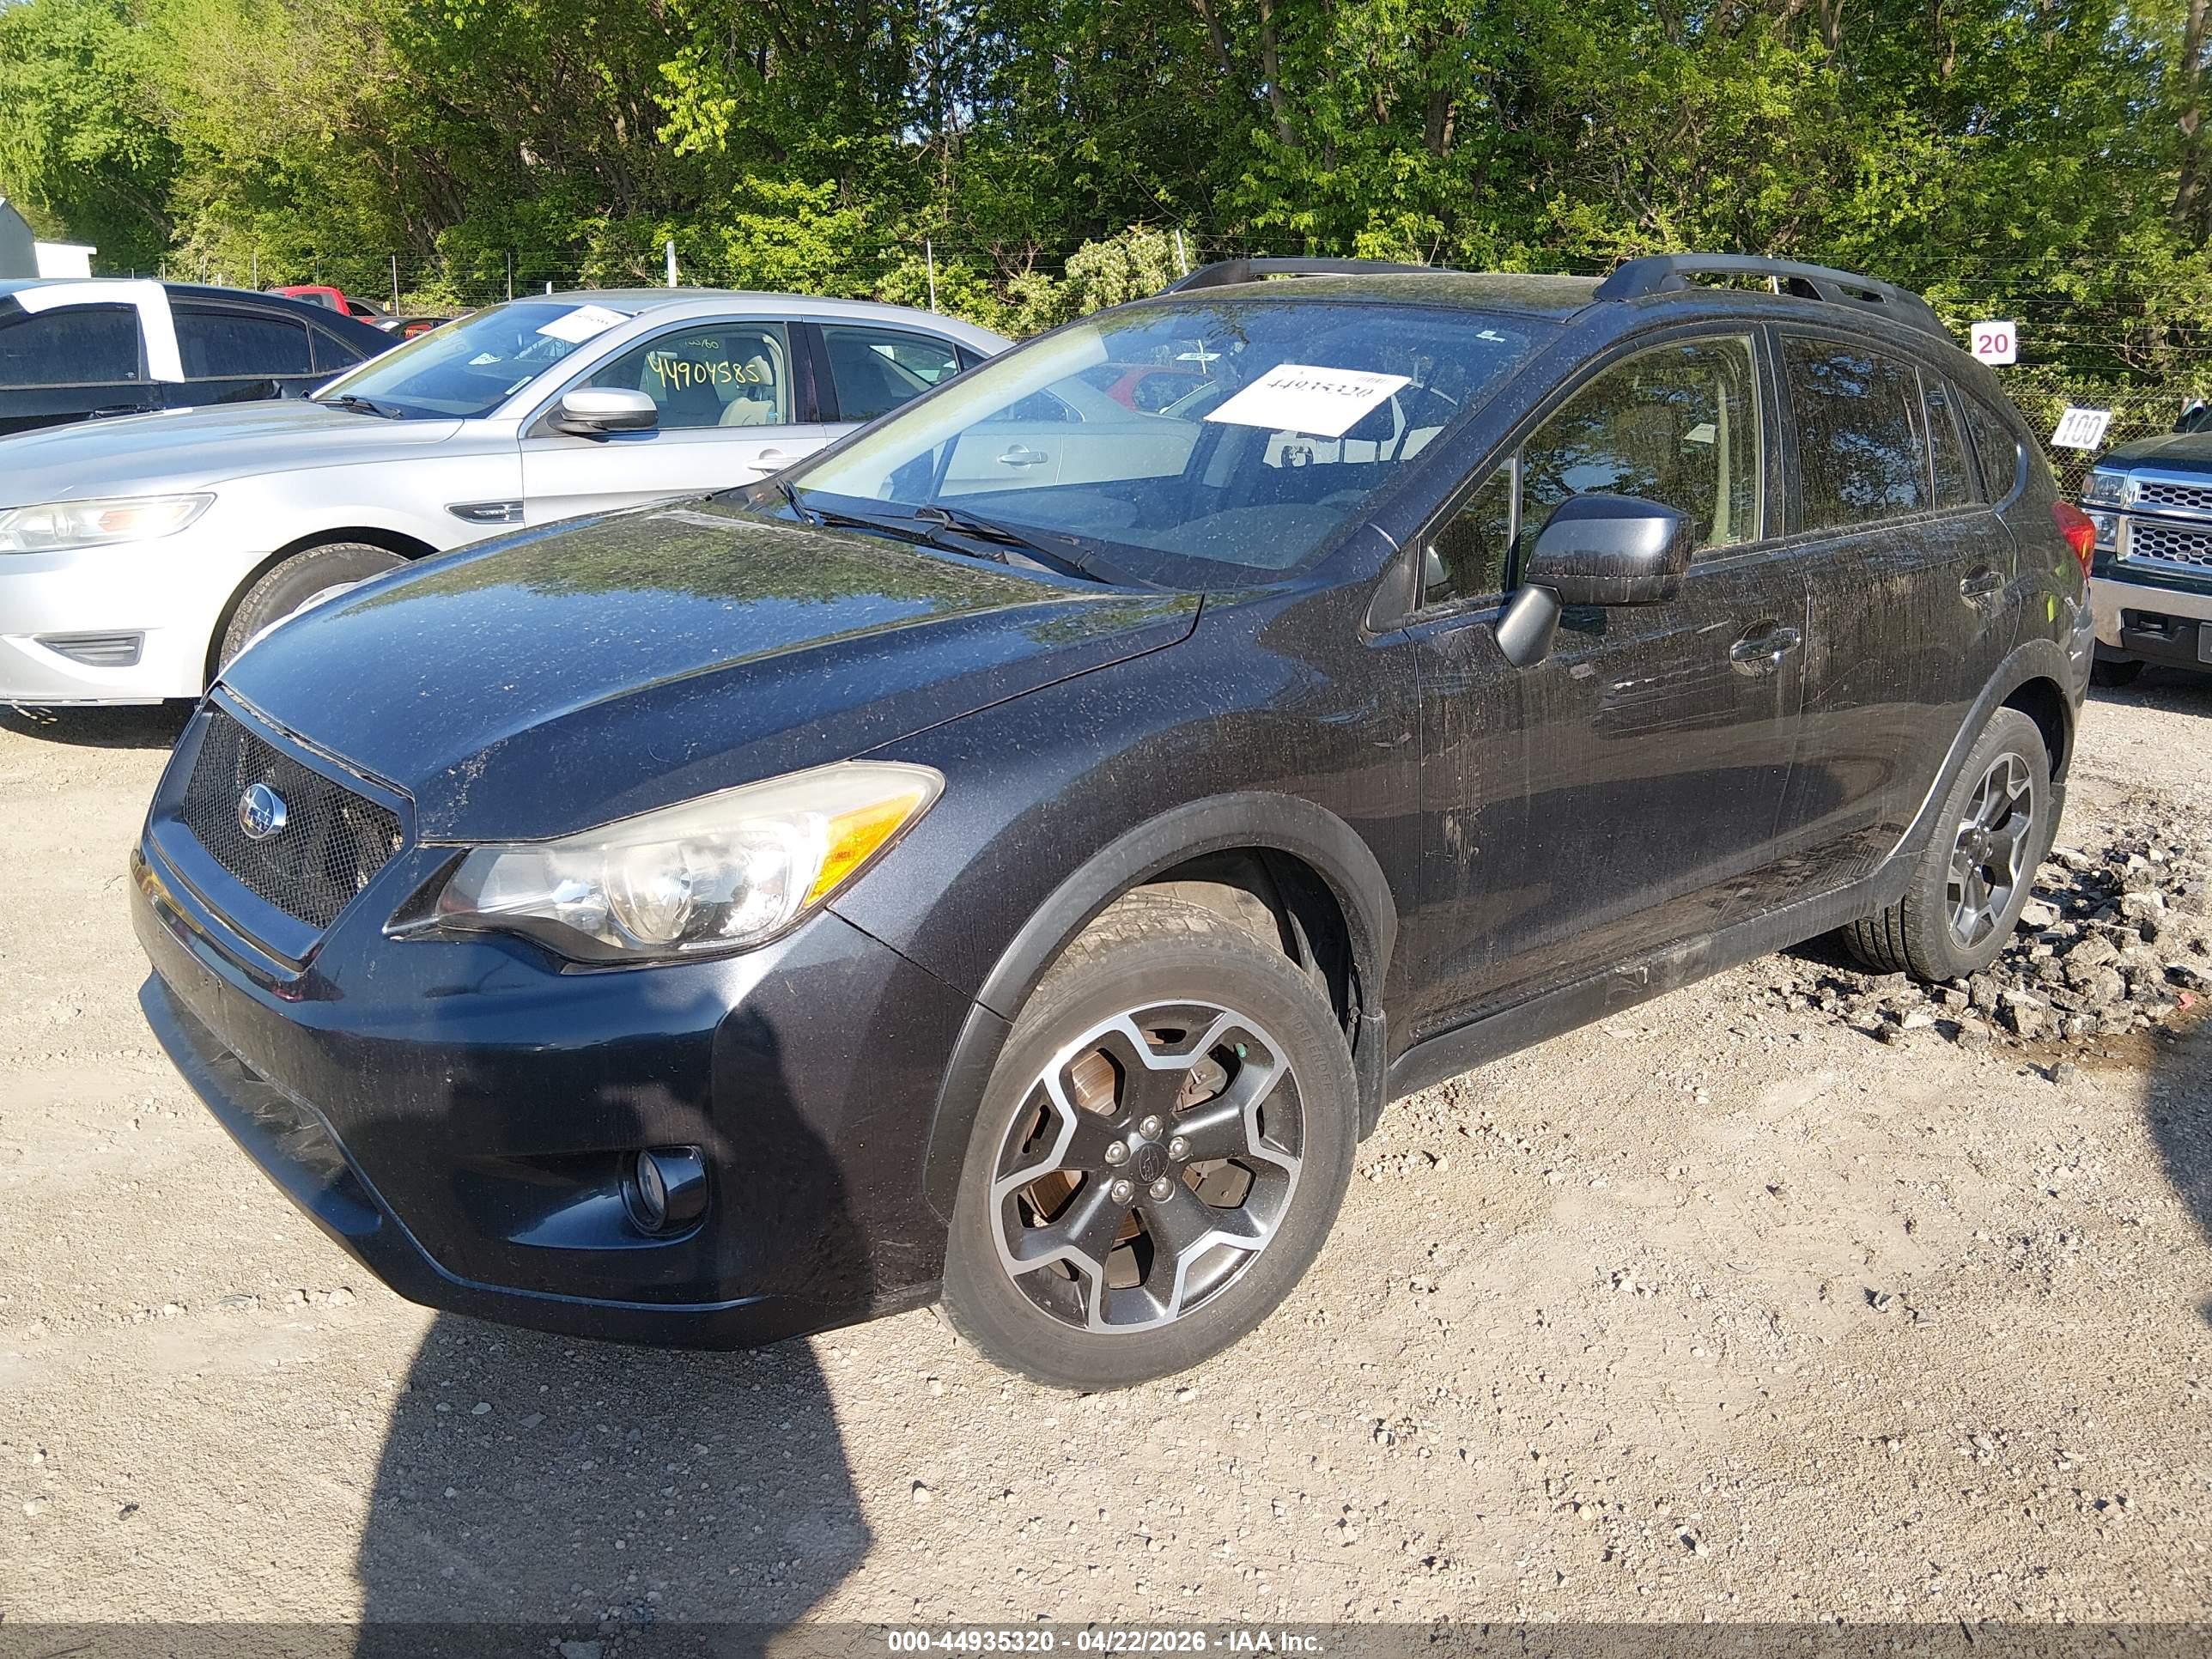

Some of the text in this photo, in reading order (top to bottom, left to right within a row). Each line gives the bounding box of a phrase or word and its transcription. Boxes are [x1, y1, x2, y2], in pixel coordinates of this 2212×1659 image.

[1978, 333, 2008, 354] 20
[647, 355, 760, 391] 44904585
[2063, 413, 2100, 445] 100
